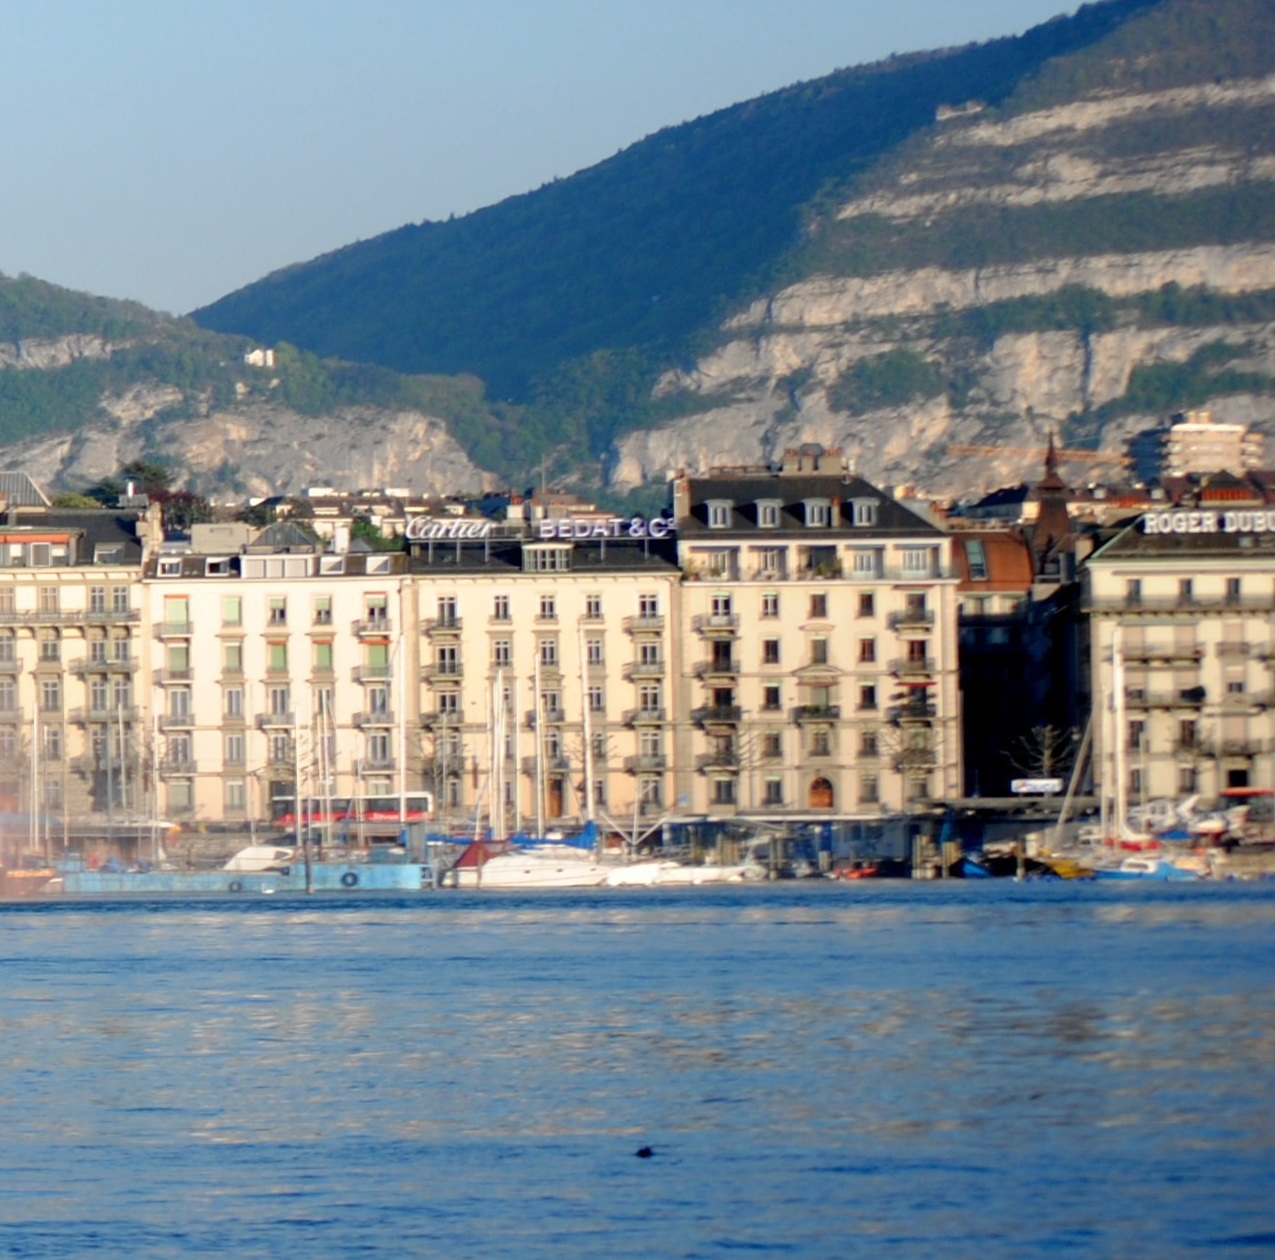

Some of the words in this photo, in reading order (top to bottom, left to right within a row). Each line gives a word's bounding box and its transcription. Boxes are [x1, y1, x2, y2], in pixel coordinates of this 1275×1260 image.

[405, 515, 500, 539] Cartier
[540, 519, 624, 537] BEDAT
[629, 518, 646, 537] &
[1143, 512, 1217, 533] ROGER
